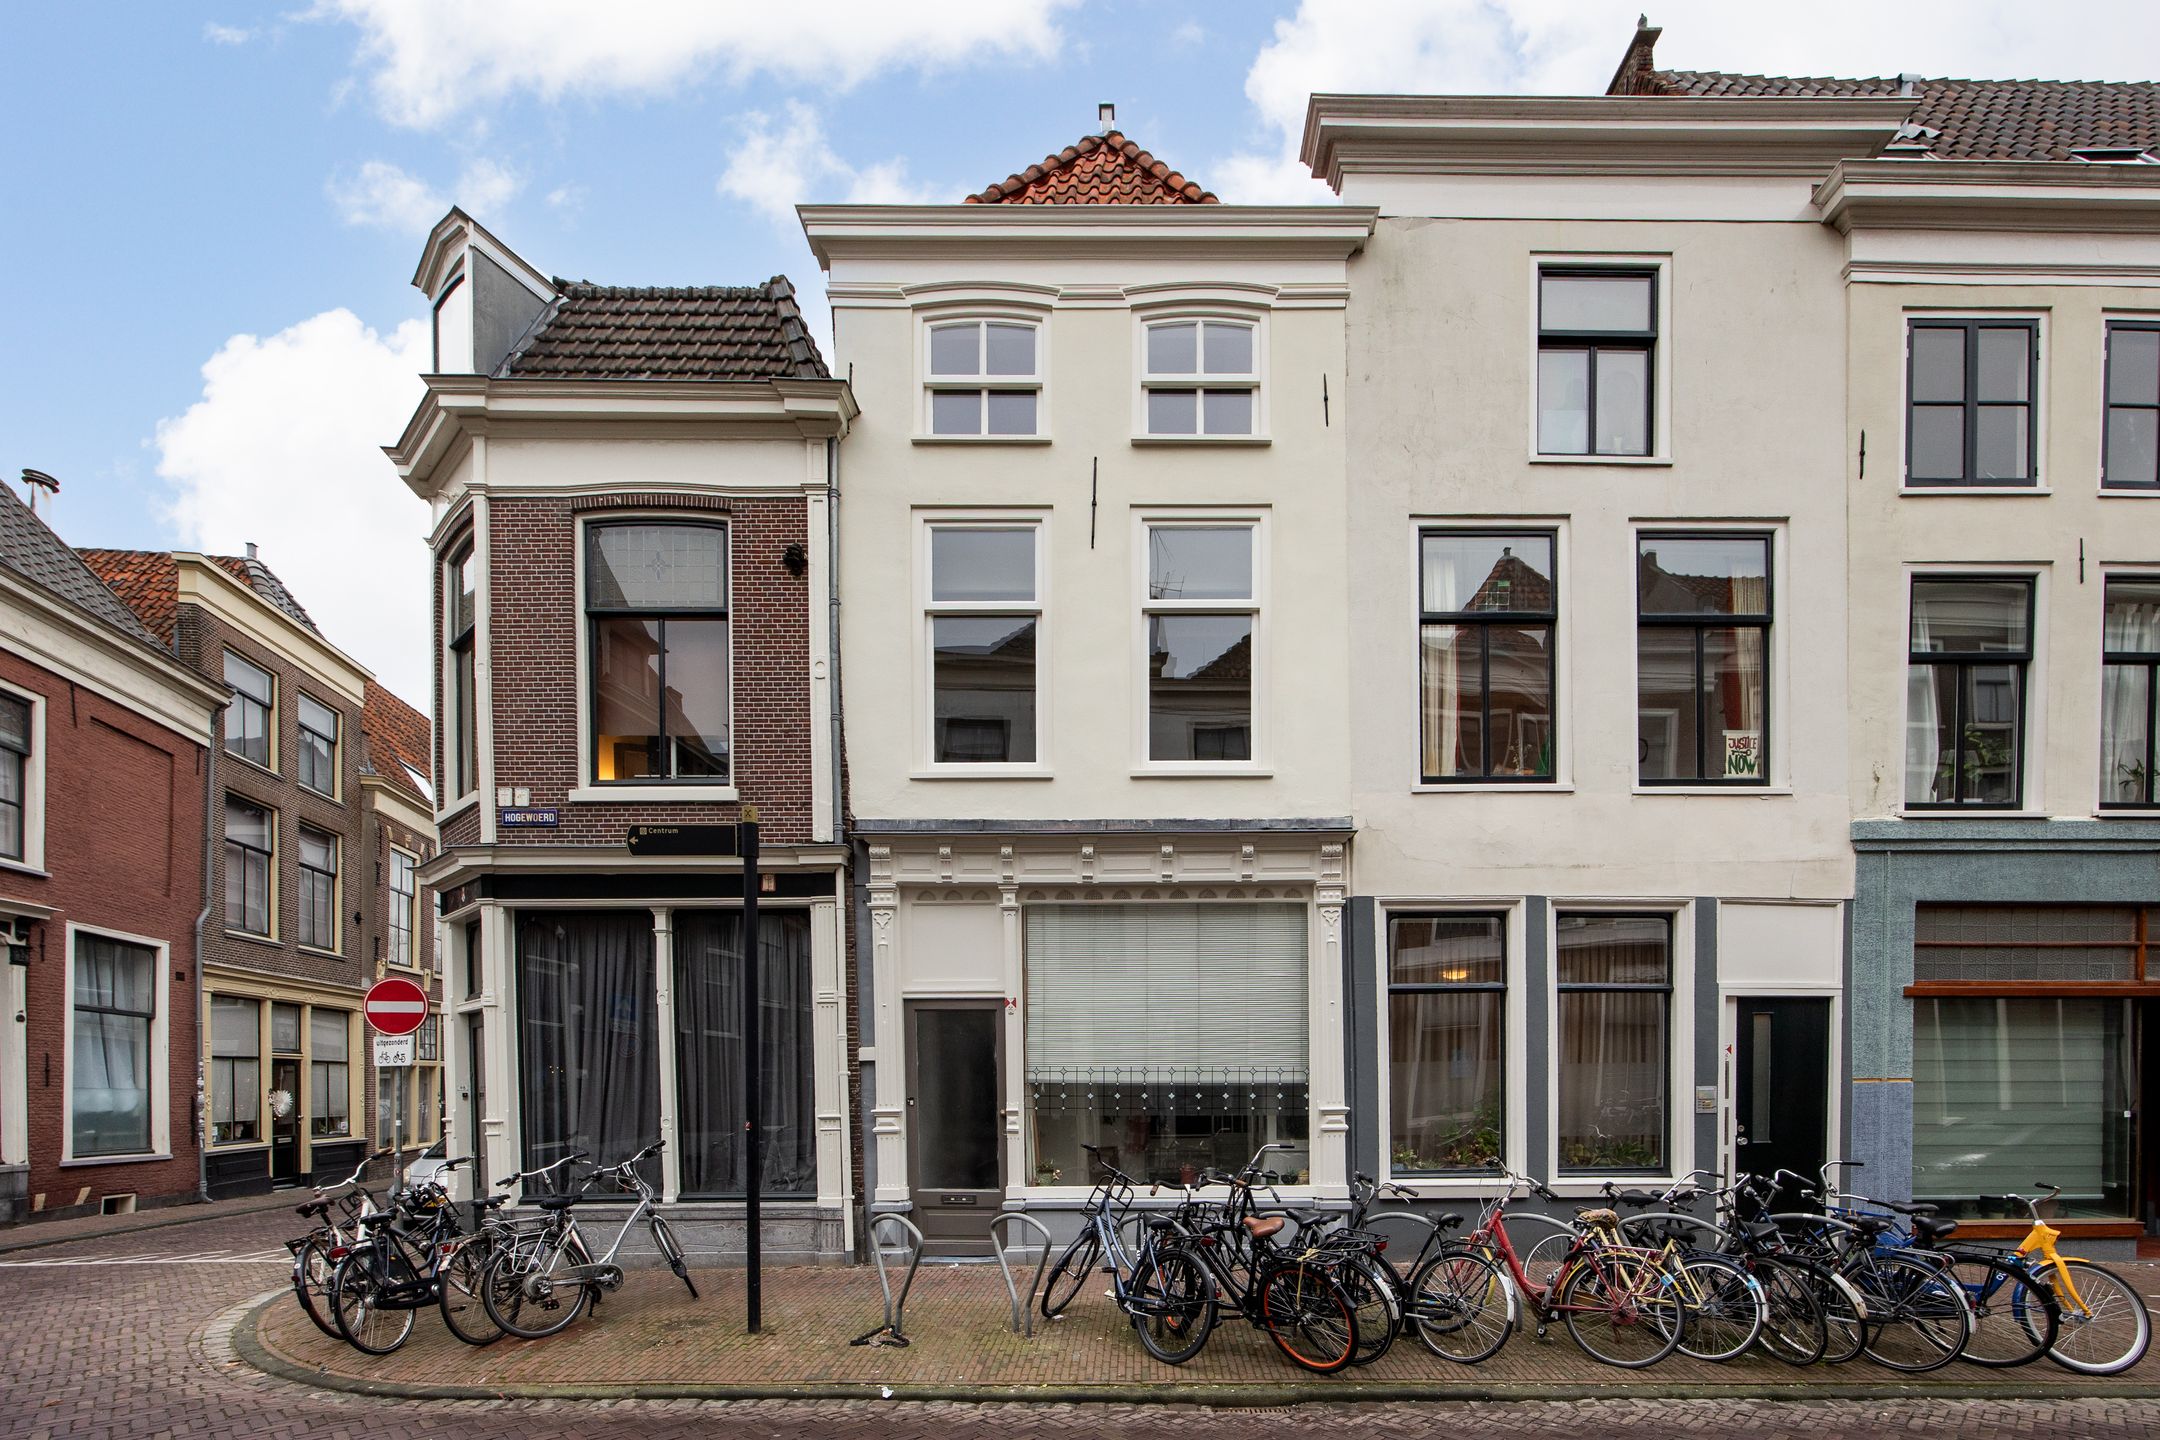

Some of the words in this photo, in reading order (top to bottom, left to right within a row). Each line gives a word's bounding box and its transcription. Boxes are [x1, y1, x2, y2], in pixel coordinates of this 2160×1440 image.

[1728, 736, 1758, 750] JUSTICE
[1728, 755, 1757, 775] NOW
[504, 813, 555, 822] HOGEWOERD
[376, 1038, 408, 1047] uitgezonderd
